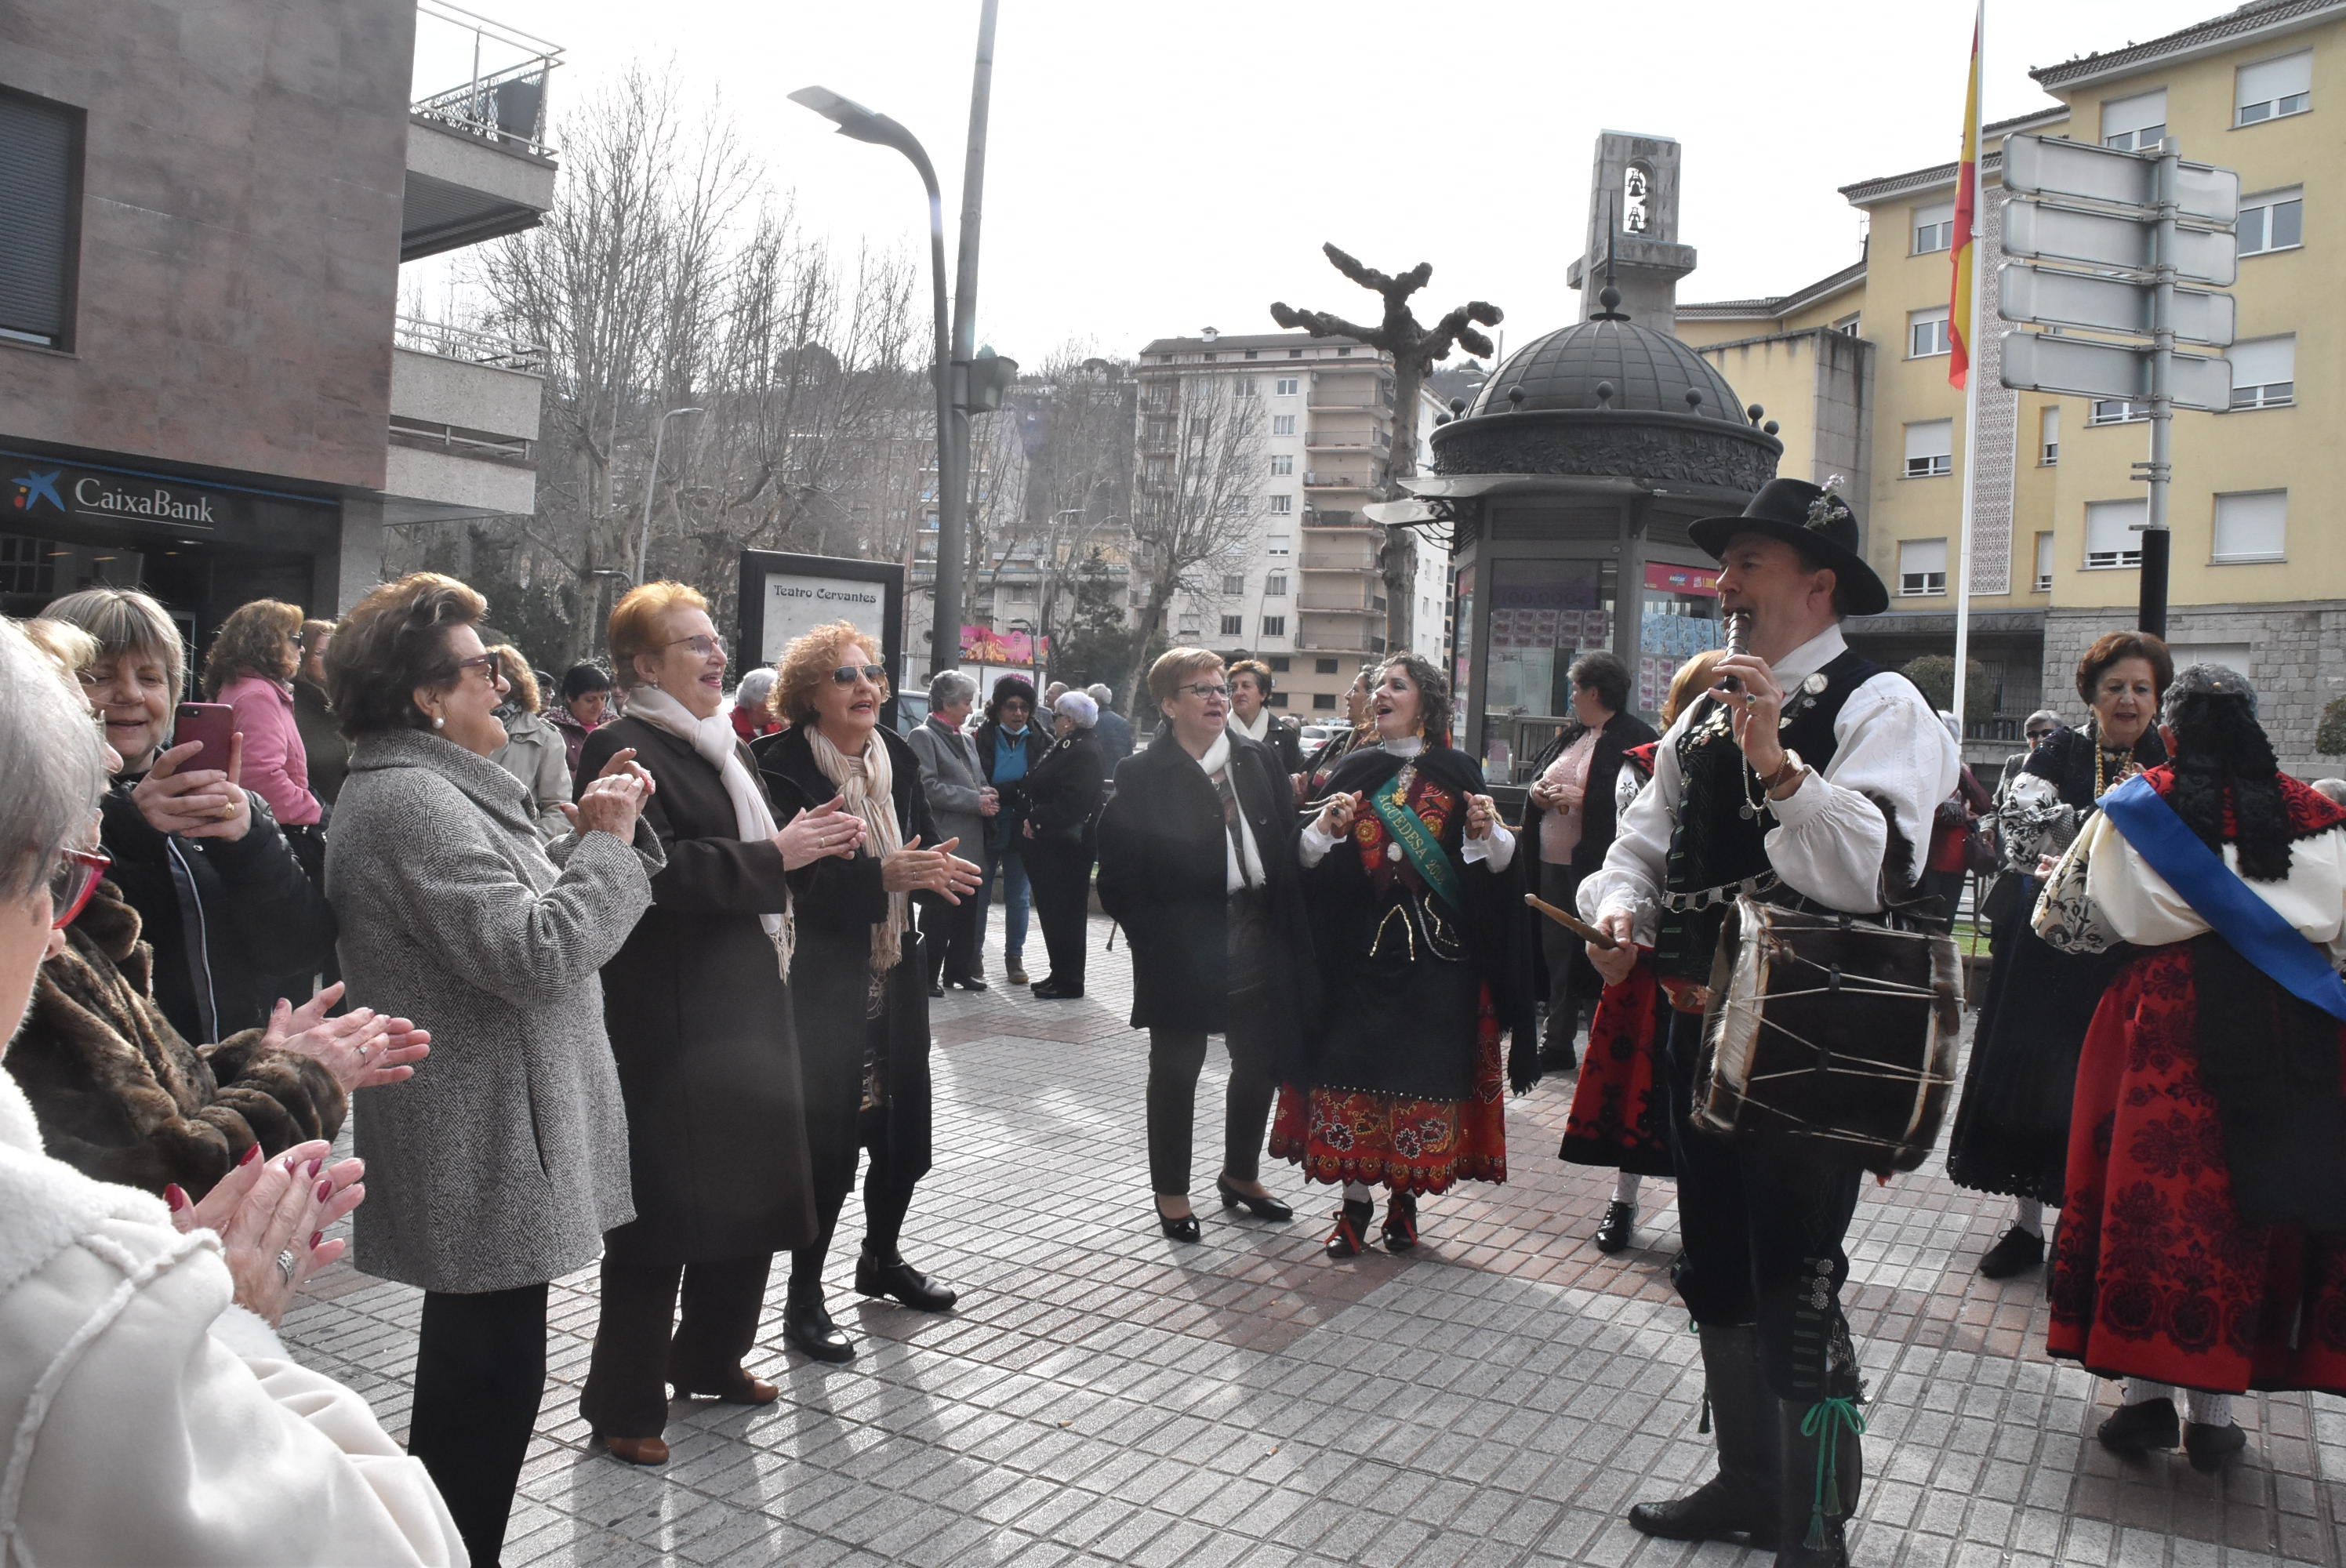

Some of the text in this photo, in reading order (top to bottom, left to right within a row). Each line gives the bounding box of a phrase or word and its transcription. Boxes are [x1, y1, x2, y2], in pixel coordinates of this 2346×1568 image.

[74, 477, 214, 523] CaixaBank
[774, 585, 877, 604] Teatro Cervantes
[1378, 794, 1428, 860] AGUEDESA
